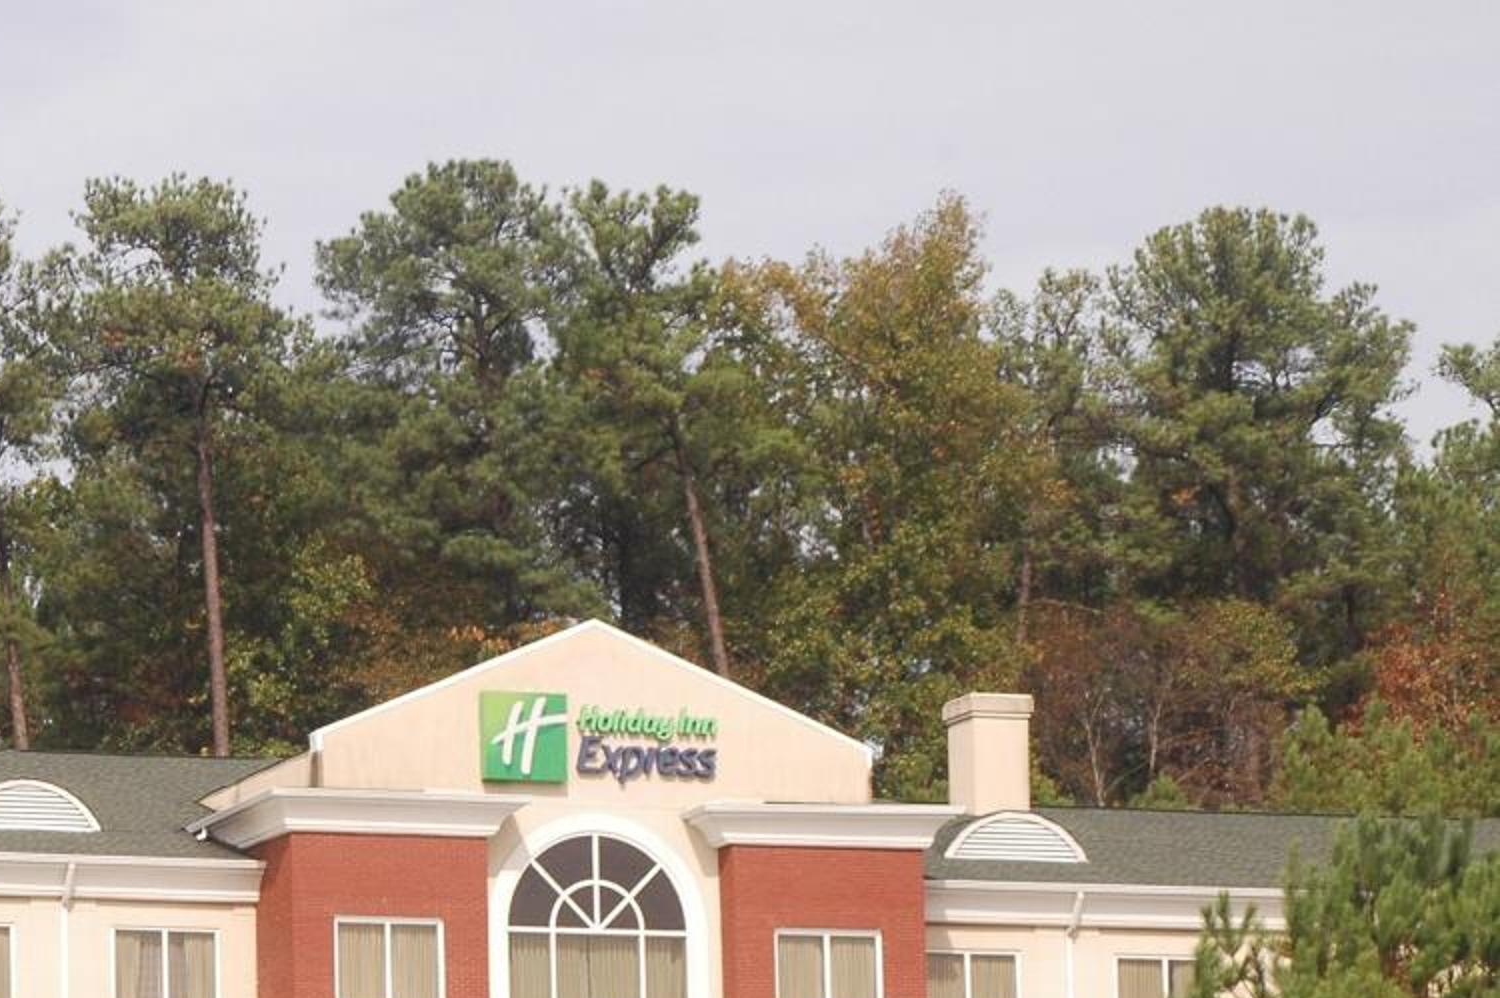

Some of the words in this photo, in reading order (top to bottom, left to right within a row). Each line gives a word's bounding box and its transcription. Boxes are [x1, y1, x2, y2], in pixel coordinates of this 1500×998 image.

[576, 703, 674, 740] Holiday
[678, 706, 718, 737] Inn
[576, 736, 717, 784] Express
